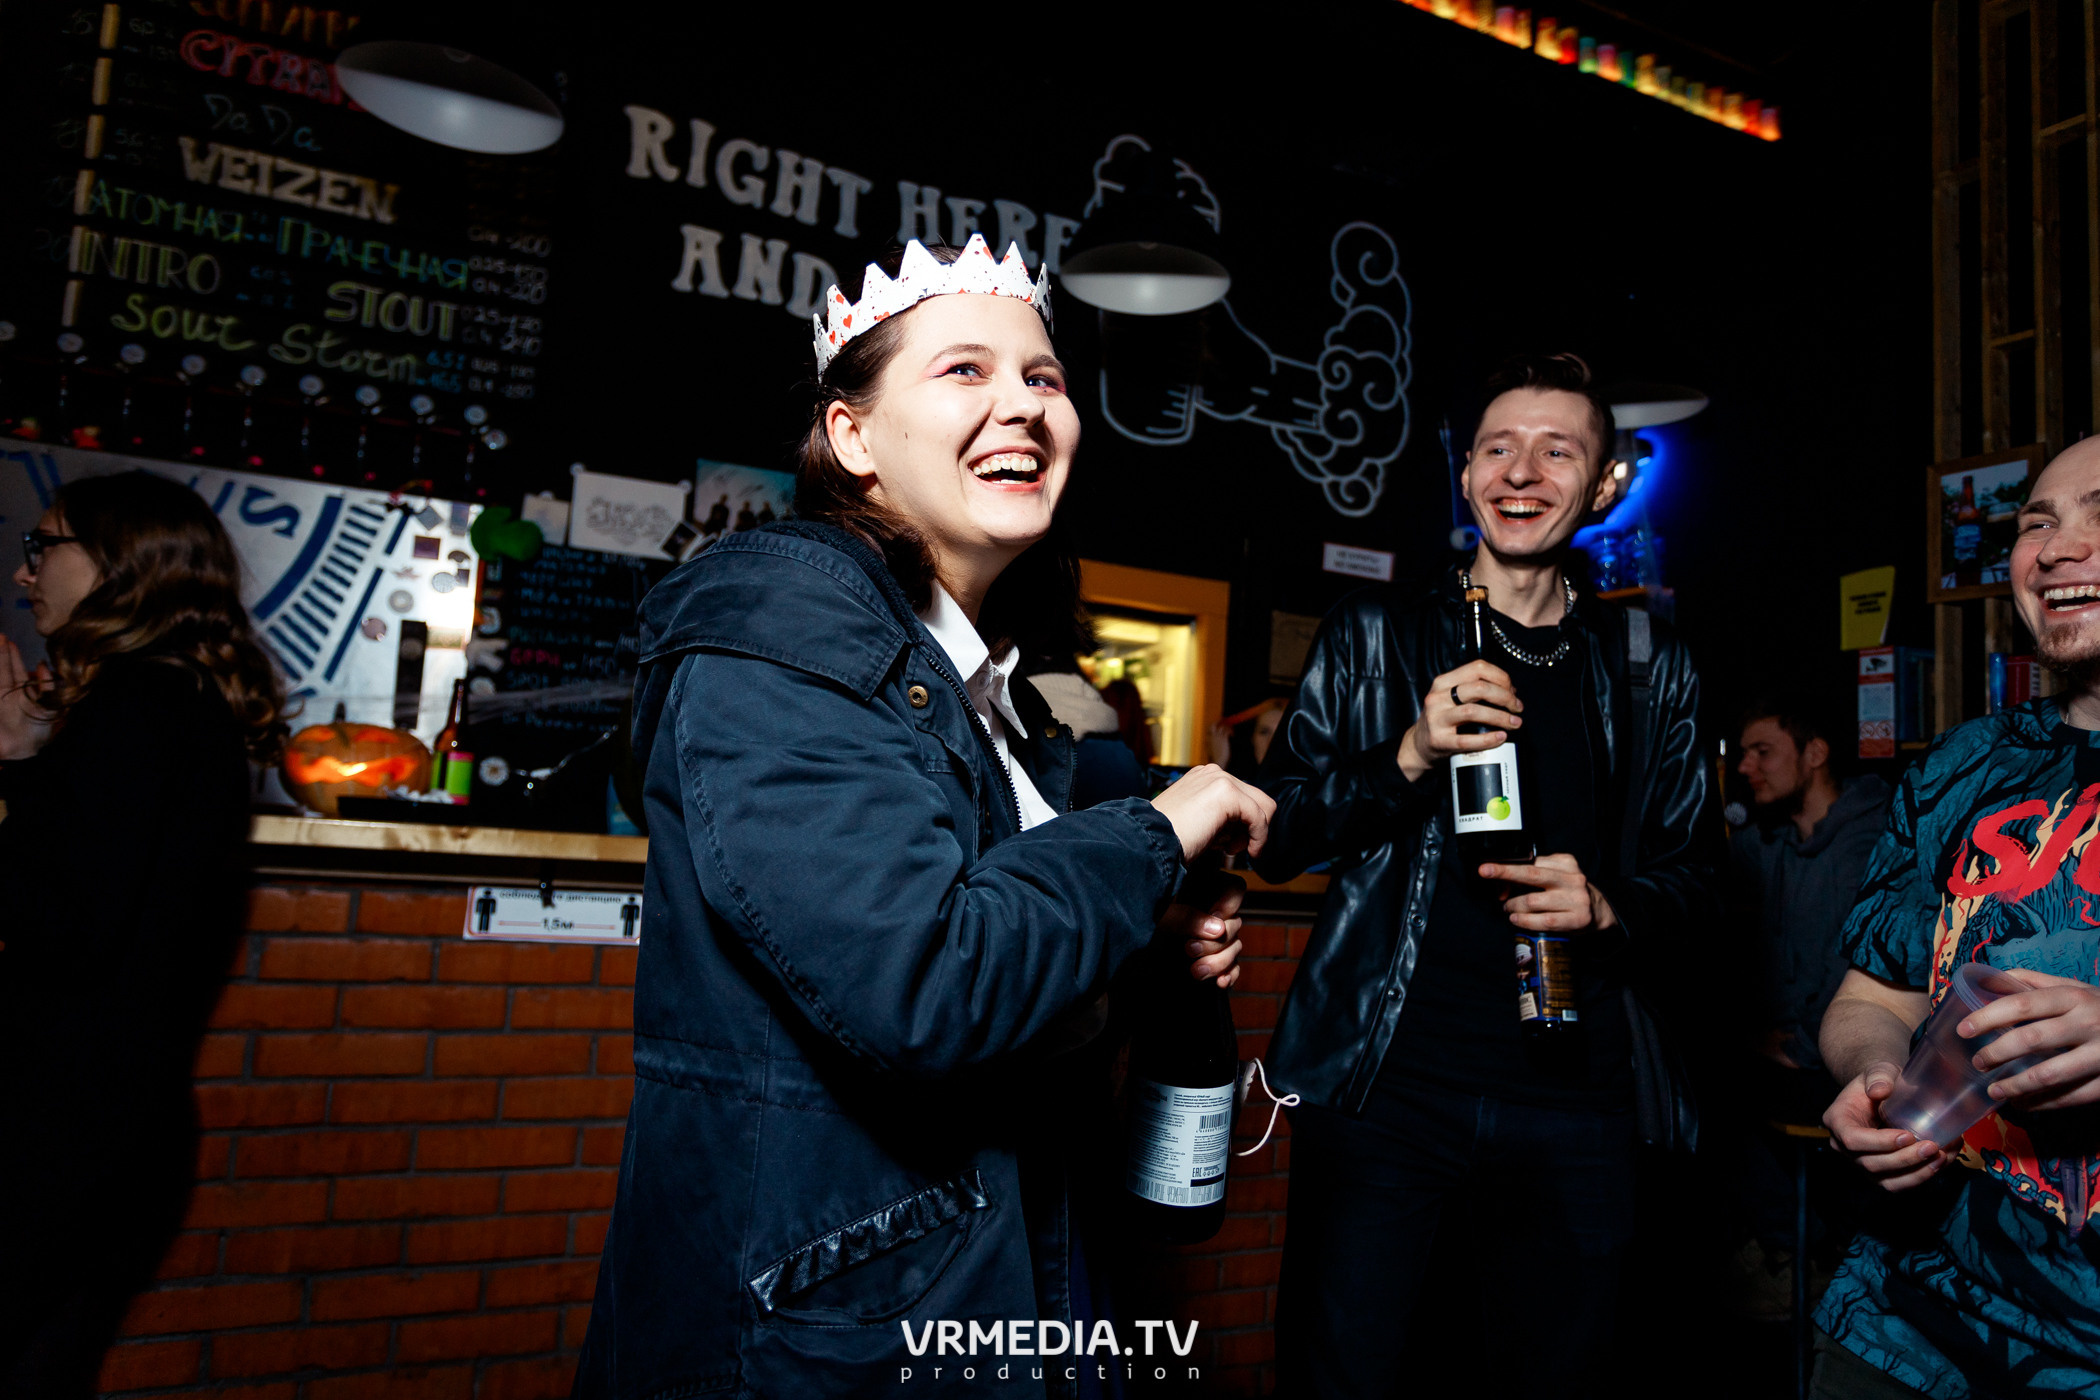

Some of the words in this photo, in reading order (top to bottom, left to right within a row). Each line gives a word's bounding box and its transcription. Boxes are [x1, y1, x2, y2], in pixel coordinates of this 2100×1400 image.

[177, 135, 401, 224] WEIZEN
[622, 102, 874, 240] RIGHT
[90, 178, 246, 244] АТОМНАЯ
[275, 215, 470, 291] ПРАЧЕЧНАЯ
[670, 223, 841, 320] AND
[109, 292, 258, 351] Sour
[267, 323, 419, 386] Storm
[323, 280, 460, 342] STOUT
